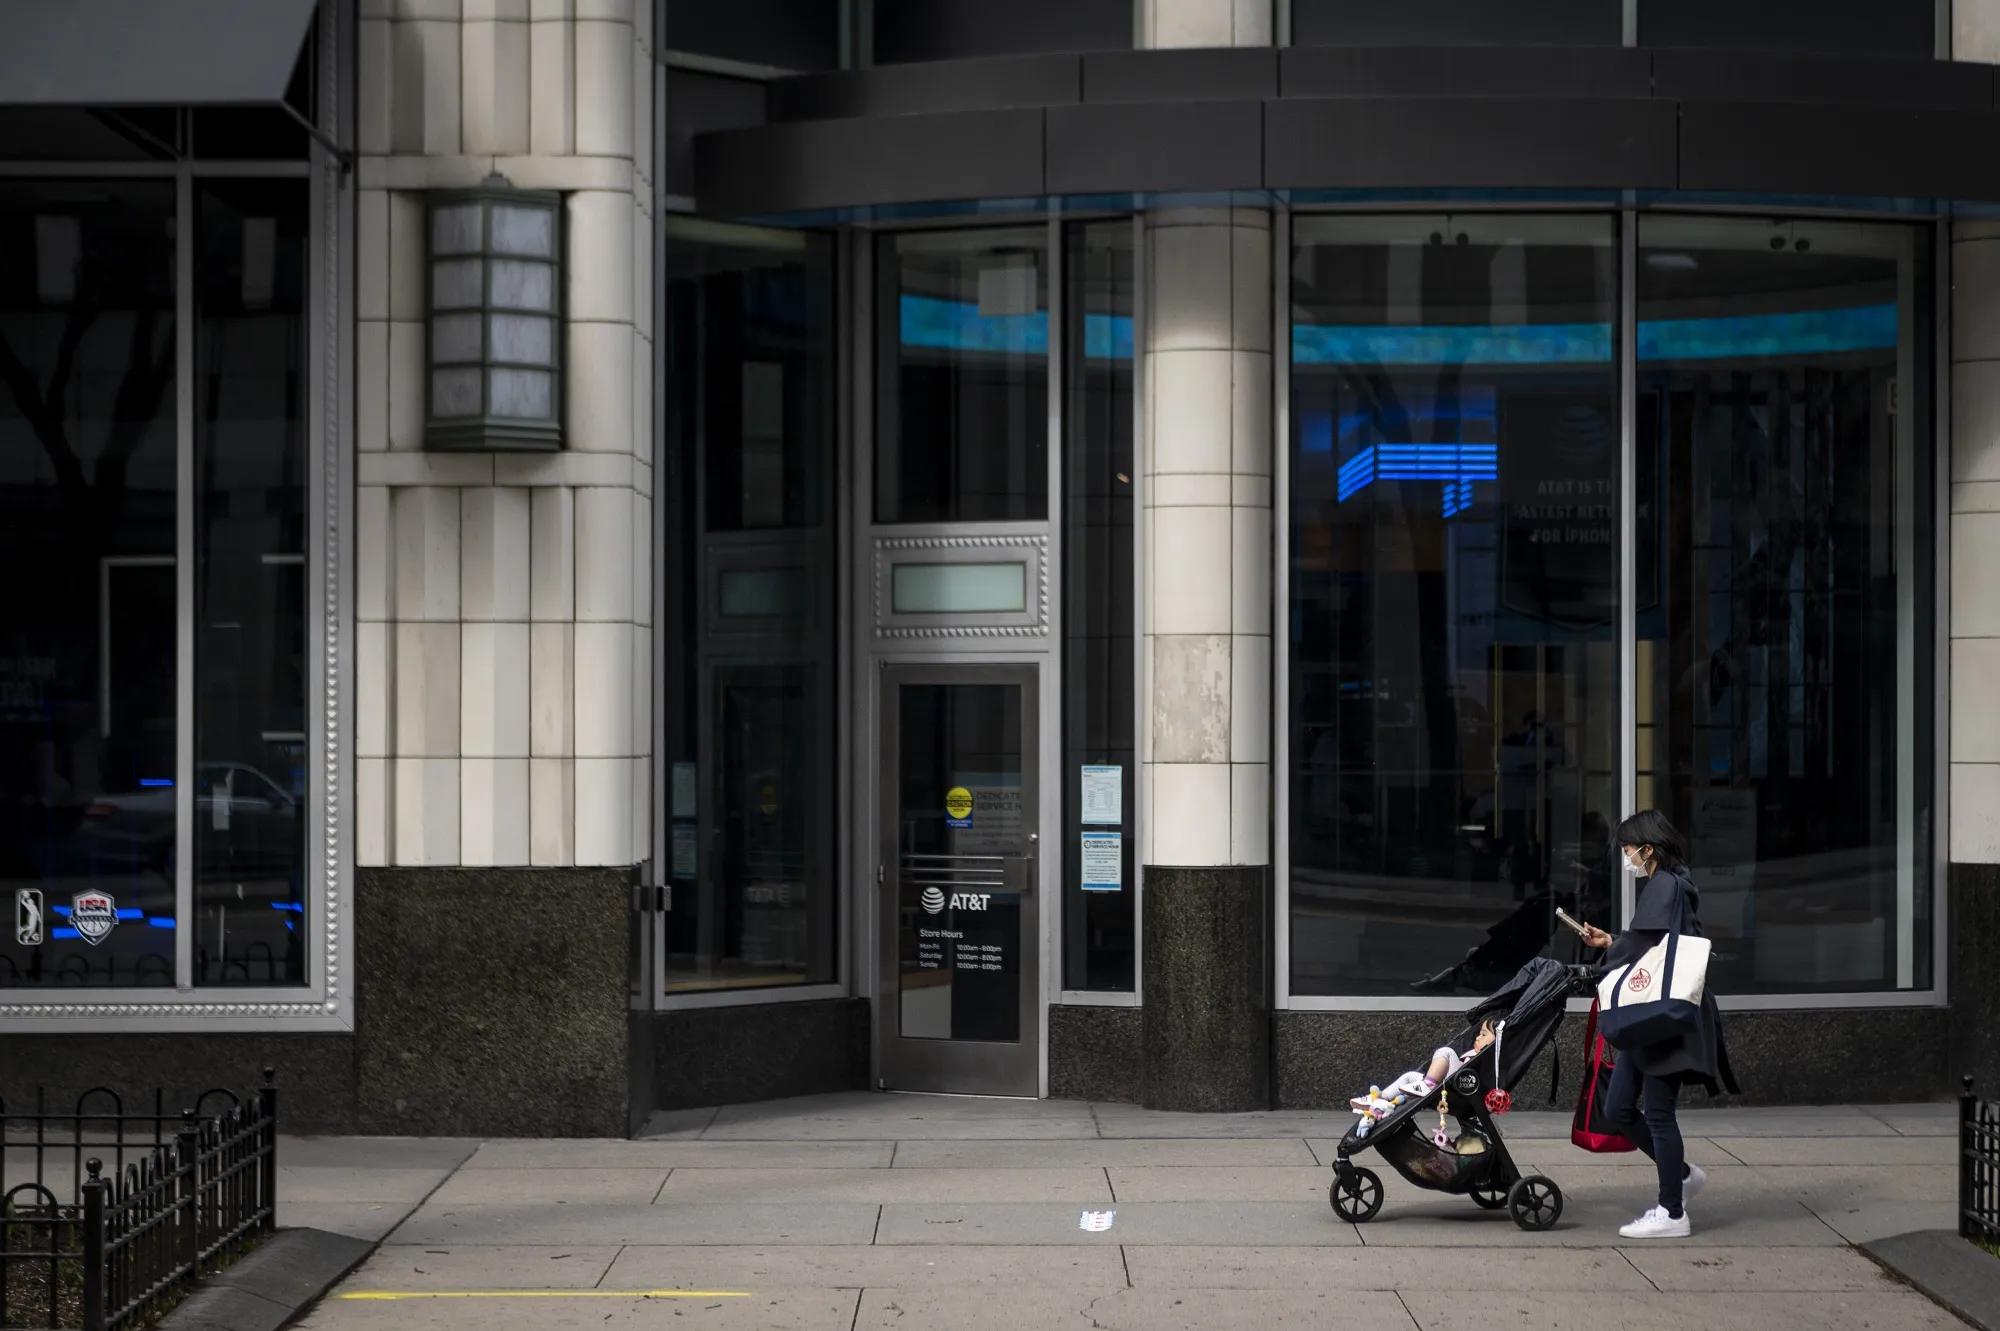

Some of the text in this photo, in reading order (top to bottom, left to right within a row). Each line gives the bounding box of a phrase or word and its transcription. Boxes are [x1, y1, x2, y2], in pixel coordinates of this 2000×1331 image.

[80, 899, 109, 913] USA
[949, 893, 991, 911] AT&T
[920, 929, 964, 939] Store Hours
[919, 952, 943, 960] Saturday
[919, 961, 939, 969] Sunday
[1459, 1076, 1472, 1084] baby
